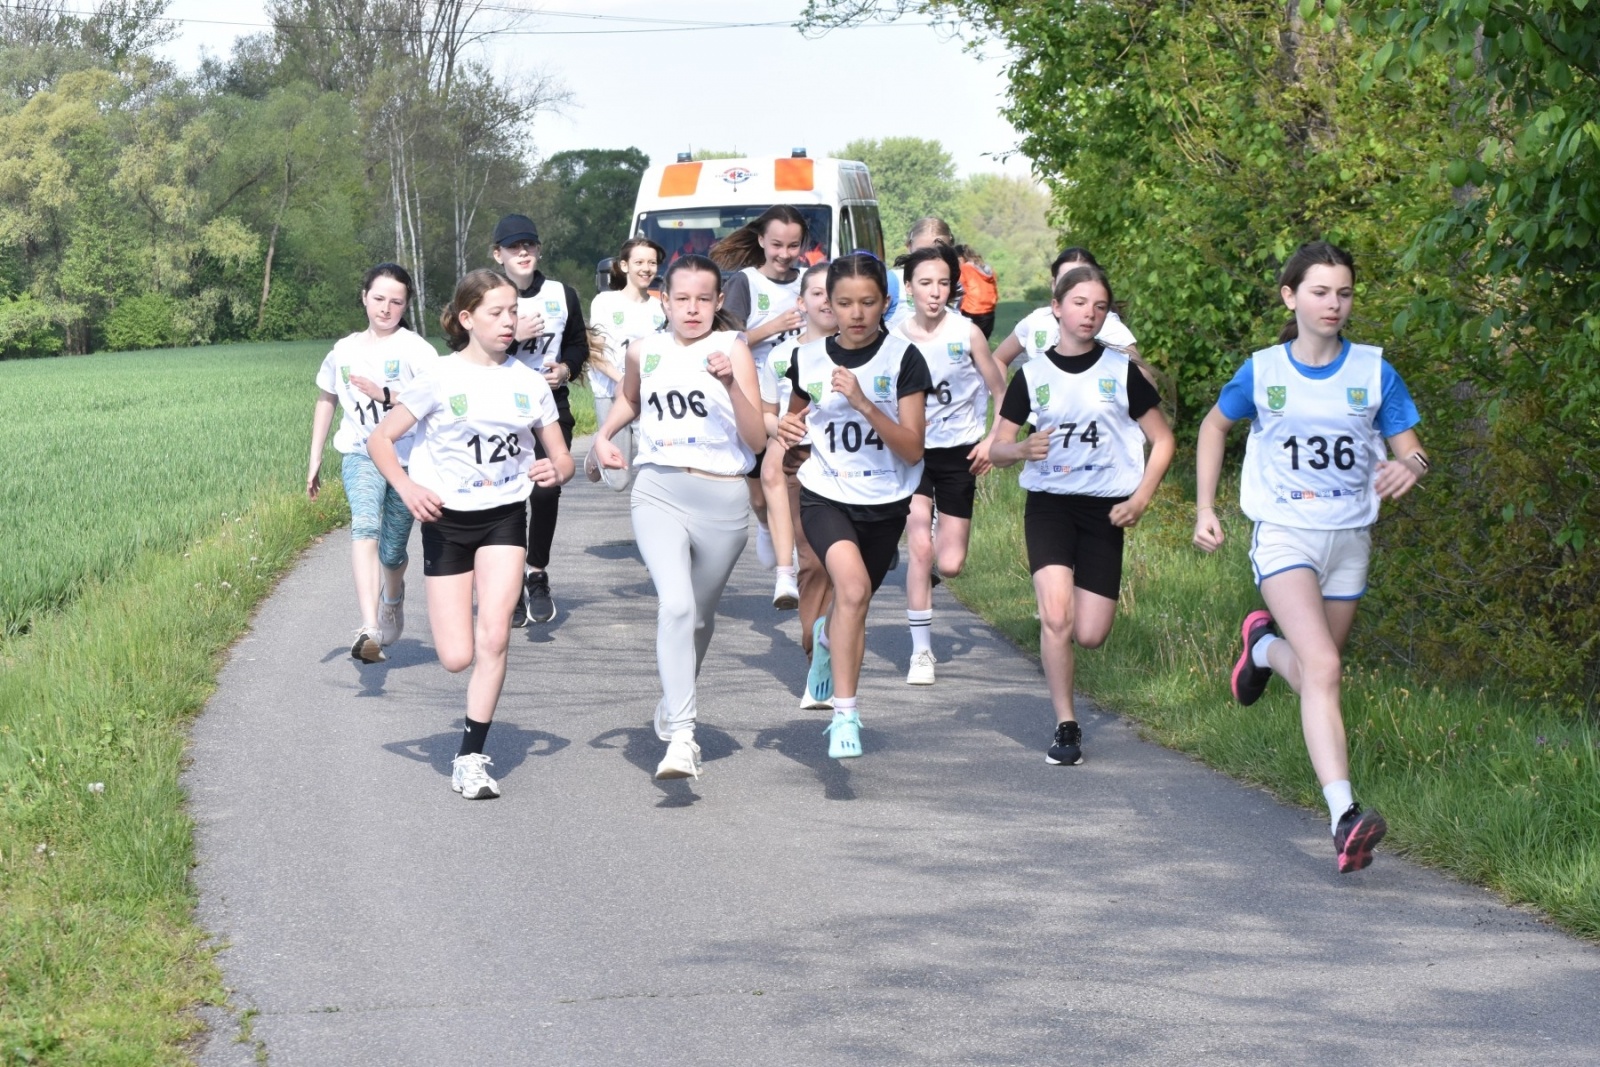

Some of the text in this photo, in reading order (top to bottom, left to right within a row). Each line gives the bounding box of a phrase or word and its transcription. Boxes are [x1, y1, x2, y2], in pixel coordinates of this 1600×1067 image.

[647, 389, 708, 421] 106
[824, 420, 884, 453] 104
[1059, 420, 1100, 448] 74
[1283, 435, 1356, 470] 136
